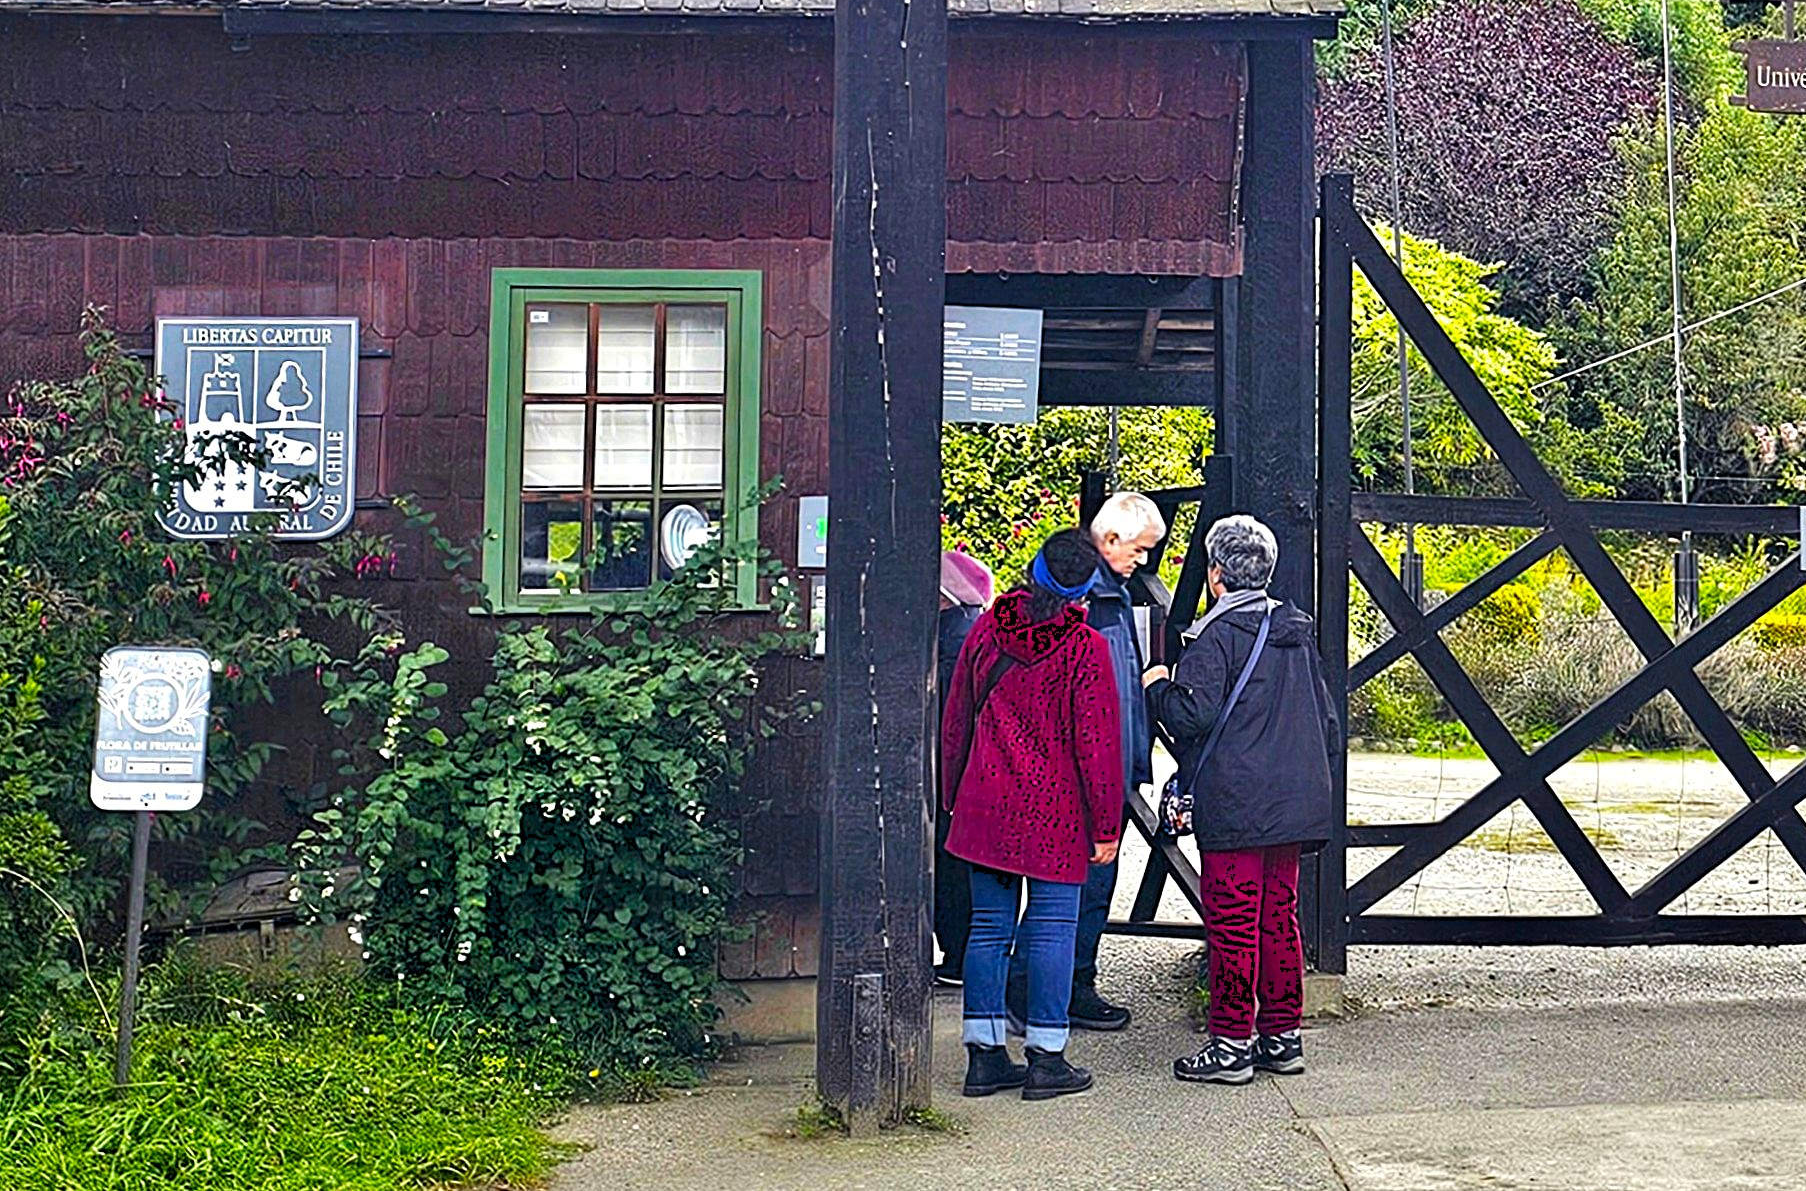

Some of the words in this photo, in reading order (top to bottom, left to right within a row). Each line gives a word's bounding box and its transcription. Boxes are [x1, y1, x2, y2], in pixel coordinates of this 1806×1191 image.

[183, 328, 258, 344] LIBERTAS
[261, 328, 333, 344] CAPITUR
[325, 430, 344, 486] CHILE
[319, 494, 342, 521] DE
[230, 514, 313, 531] AURAL
